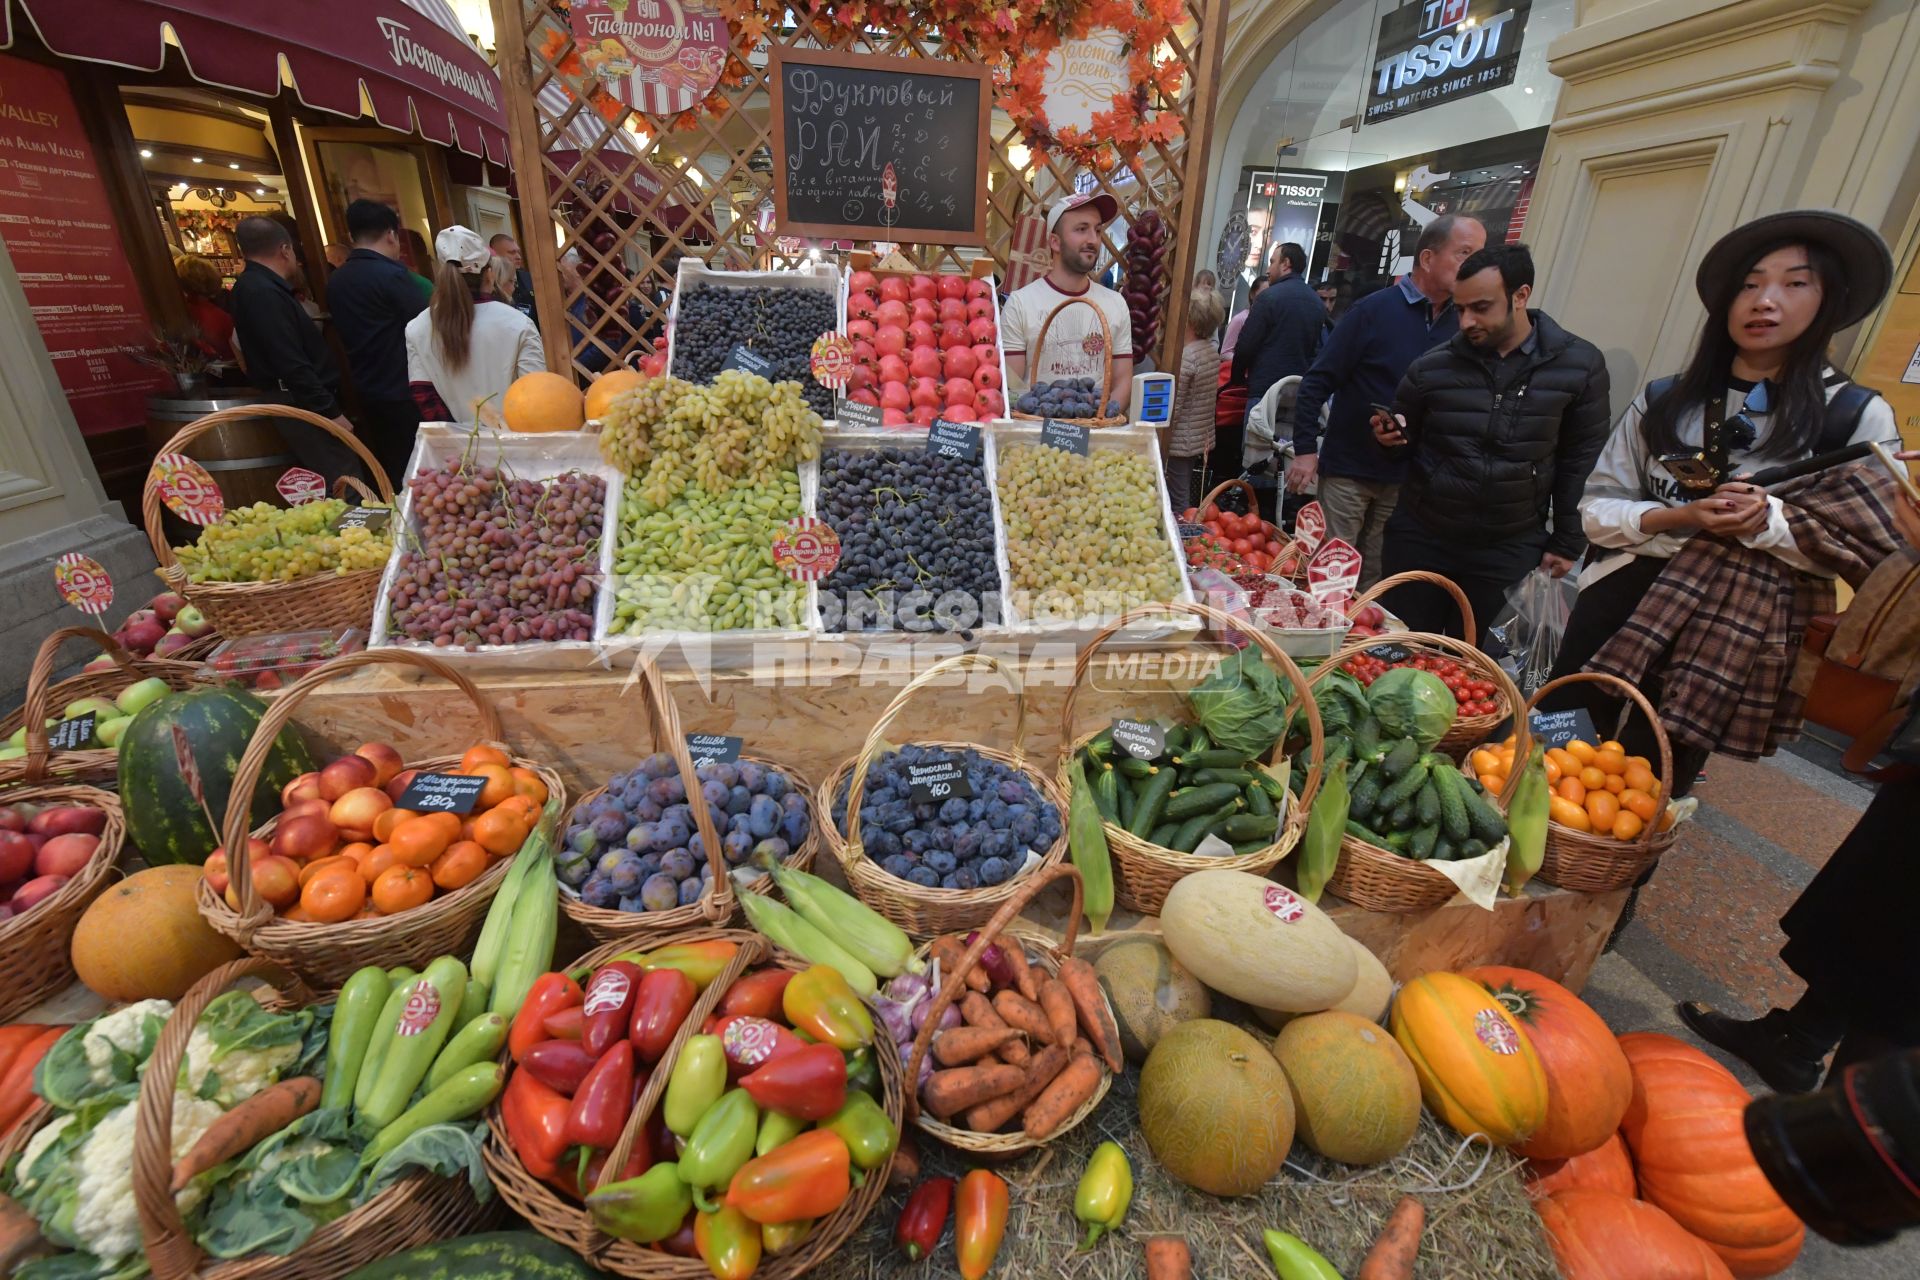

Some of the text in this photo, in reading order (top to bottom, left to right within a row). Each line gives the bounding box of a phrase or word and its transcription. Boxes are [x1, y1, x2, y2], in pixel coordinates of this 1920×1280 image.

[585, 13, 715, 42] Гастроном №1
[376, 16, 485, 102] Гастроном
[1374, 8, 1515, 95] TISSOT
[789, 69, 953, 117] Фруктовый
[1368, 66, 1502, 117] SWISS WATCHES SINCE 1853
[788, 116, 881, 171] РАЙ
[788, 171, 817, 187] Все
[1279, 185, 1323, 198] TISSOT
[93, 304, 124, 313] Blogging
[418, 794, 456, 810] 280р
[930, 782, 951, 797] 160
